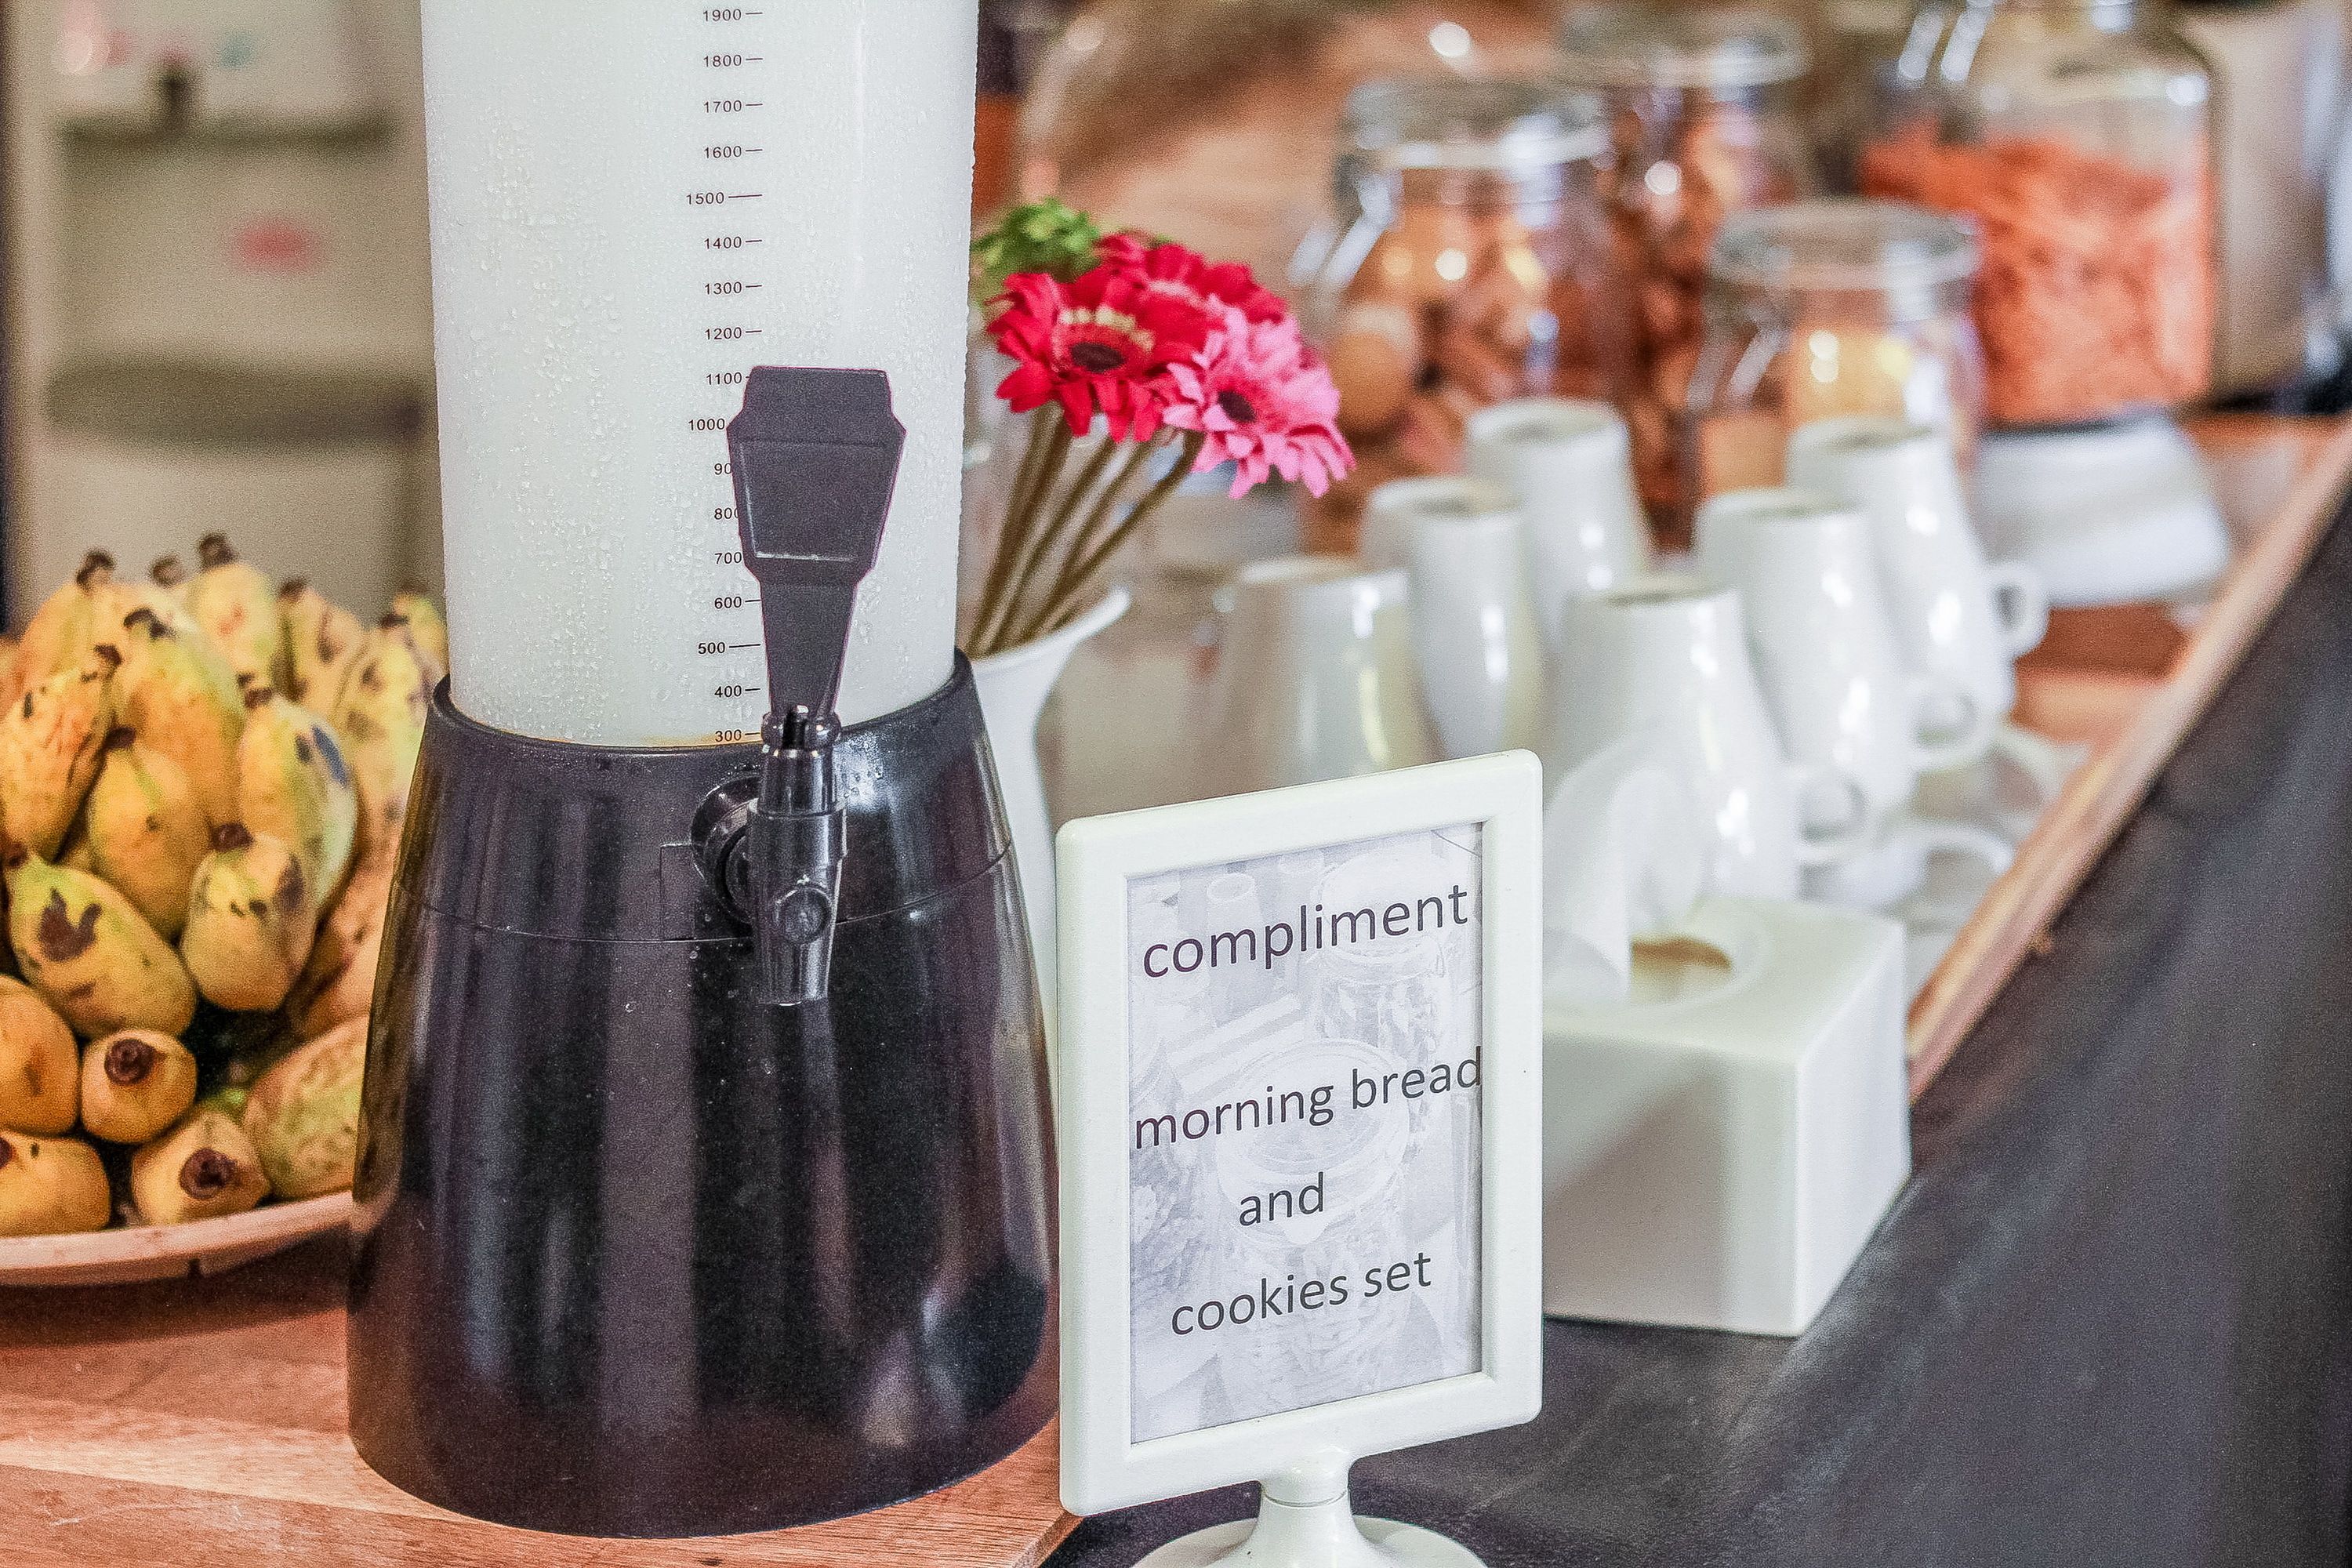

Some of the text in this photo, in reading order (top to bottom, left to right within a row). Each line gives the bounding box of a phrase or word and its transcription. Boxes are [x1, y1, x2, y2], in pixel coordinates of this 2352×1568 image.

[702, 8, 742, 22] 1900
[702, 54, 742, 68] 1800
[703, 100, 742, 114] 1700
[703, 145, 742, 159] 1600
[685, 191, 724, 205] 1500
[703, 236, 742, 250] 1400
[704, 281, 742, 296] 1300
[704, 326, 742, 340] 1200
[705, 372, 742, 386] 1100
[688, 418, 725, 431] 1000
[713, 463, 732, 476] 90
[714, 551, 742, 564] 700
[714, 596, 742, 610] 600
[698, 641, 726, 655] 500
[713, 684, 742, 699] 400
[714, 728, 742, 742] 300
[1142, 884, 1468, 978] compliment
[1135, 1045, 1482, 1150] morning bread
[1238, 1171, 1325, 1227] and
[1171, 1251, 1432, 1336] cookies set
